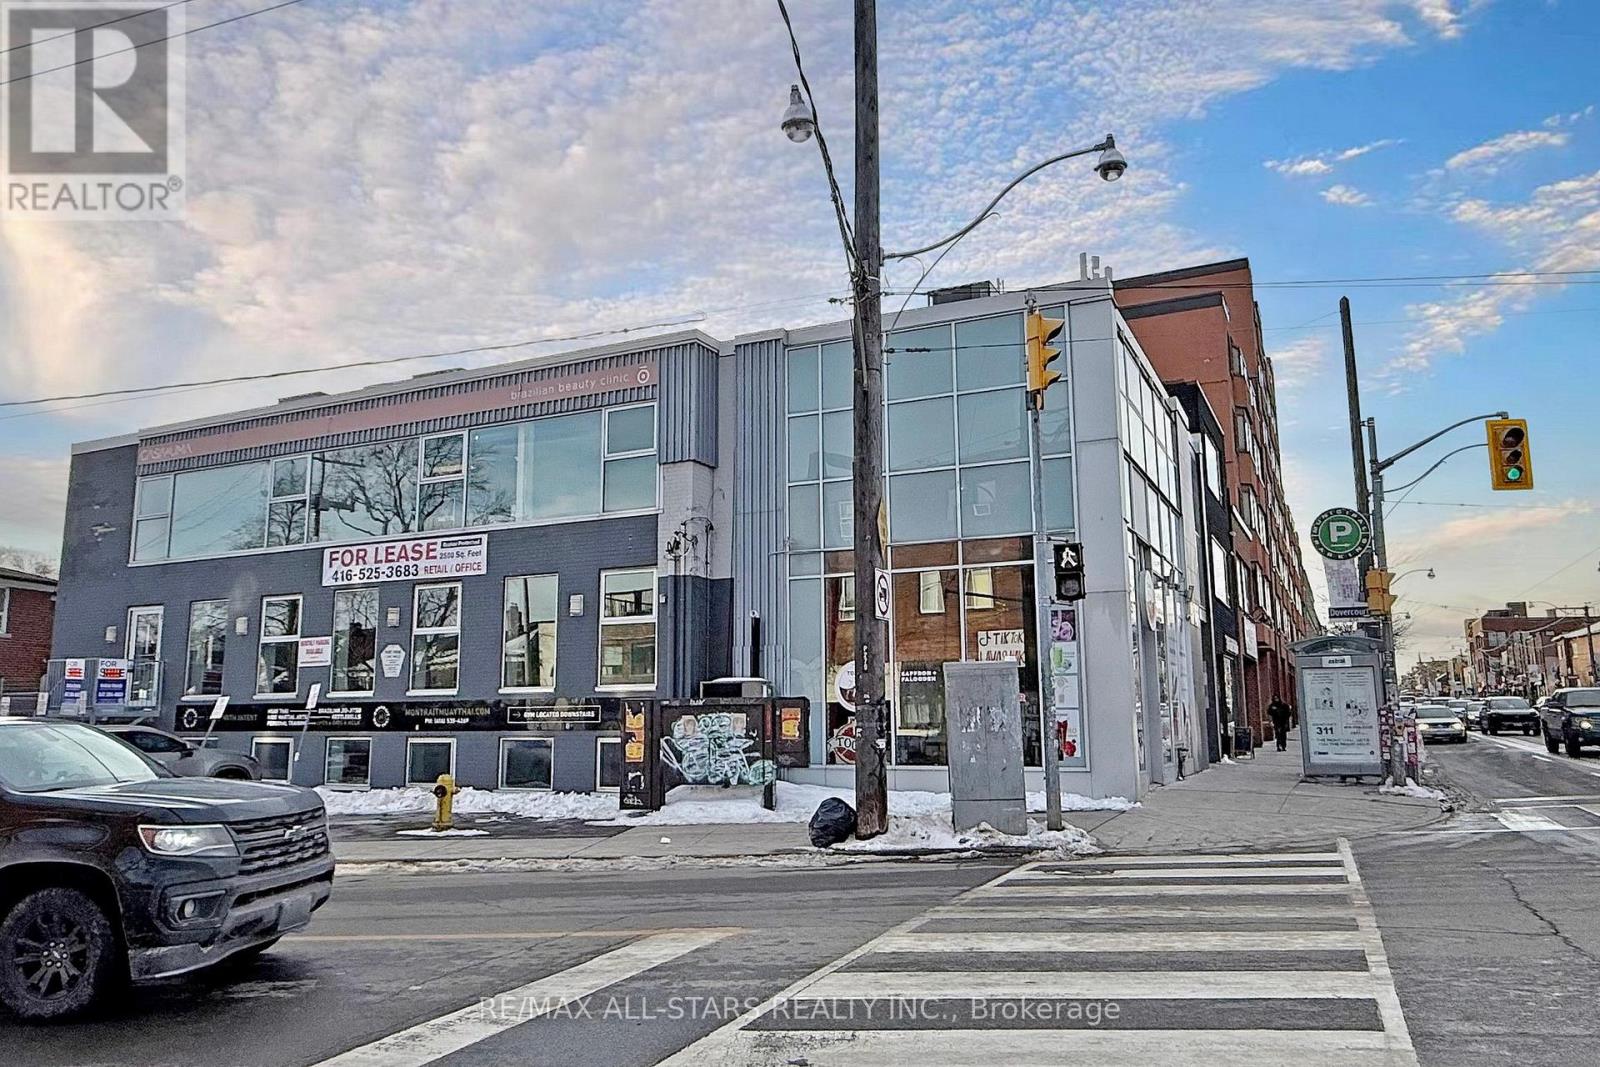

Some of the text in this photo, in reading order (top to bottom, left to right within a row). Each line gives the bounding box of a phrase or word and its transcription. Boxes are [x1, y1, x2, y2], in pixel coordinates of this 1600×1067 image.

[511, 374, 629, 401] brazilian beauty clinic
[1329, 521, 1353, 543] P
[328, 541, 438, 568] FOR LEASE
[331, 563, 420, 582] 416-525-3683
[424, 564, 448, 575] RETAIL
[455, 561, 482, 573] OFFICE
[101, 660, 117, 668] FOR
[1316, 726, 1335, 735] 311
